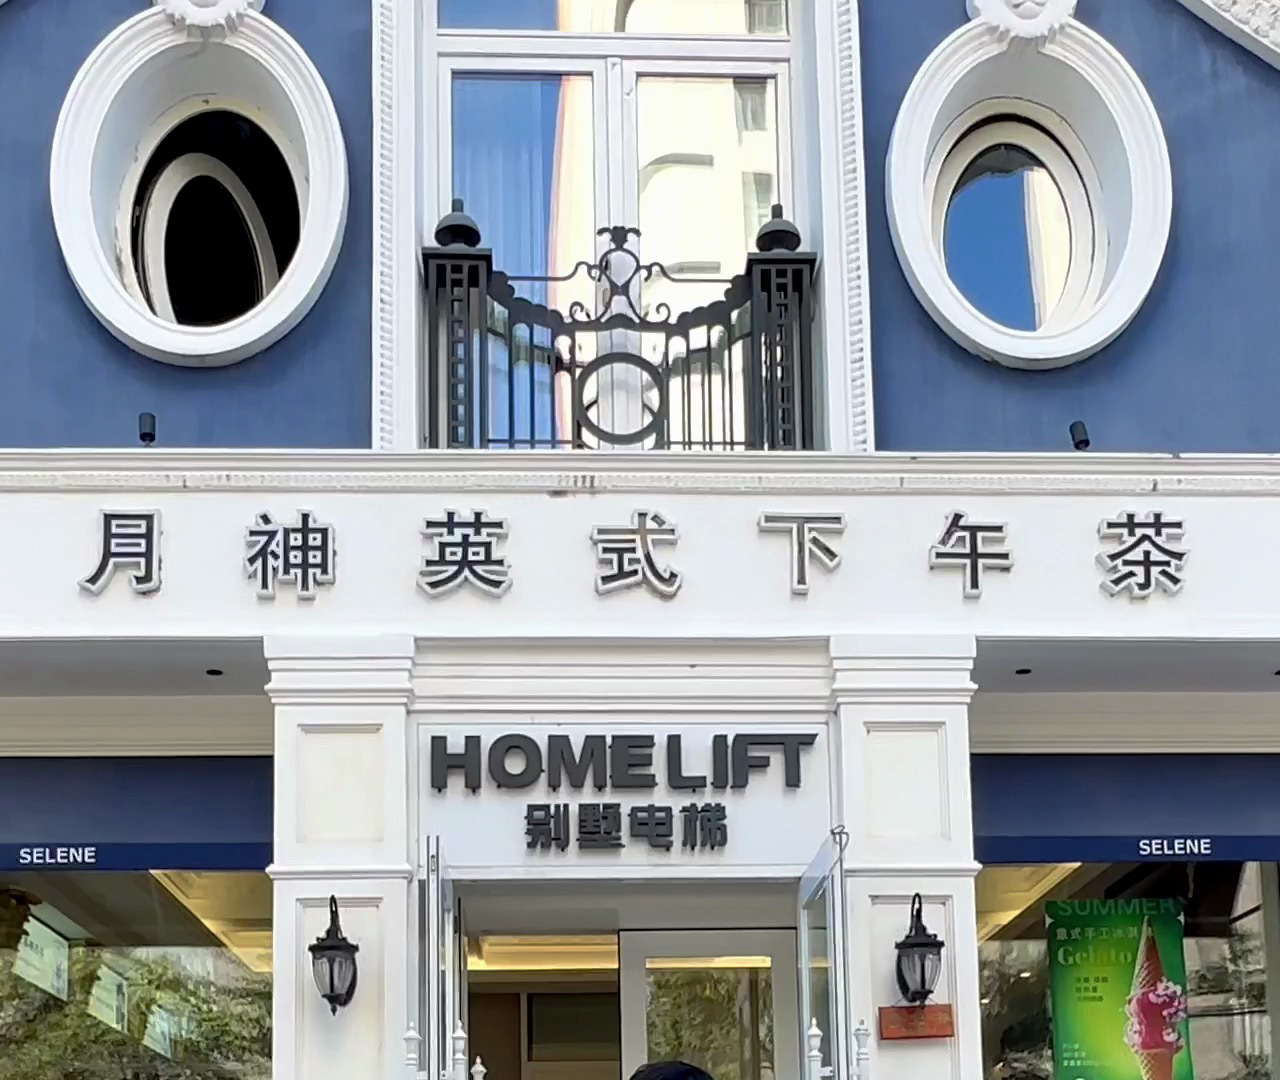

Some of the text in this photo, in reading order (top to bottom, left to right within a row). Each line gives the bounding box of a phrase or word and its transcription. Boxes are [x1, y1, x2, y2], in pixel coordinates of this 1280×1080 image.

[80, 509, 1191, 602] 月神英式下午茶
[524, 803, 728, 851] 别墅电梯
[18, 846, 97, 864] SELENE
[1138, 838, 1212, 856] SELENE
